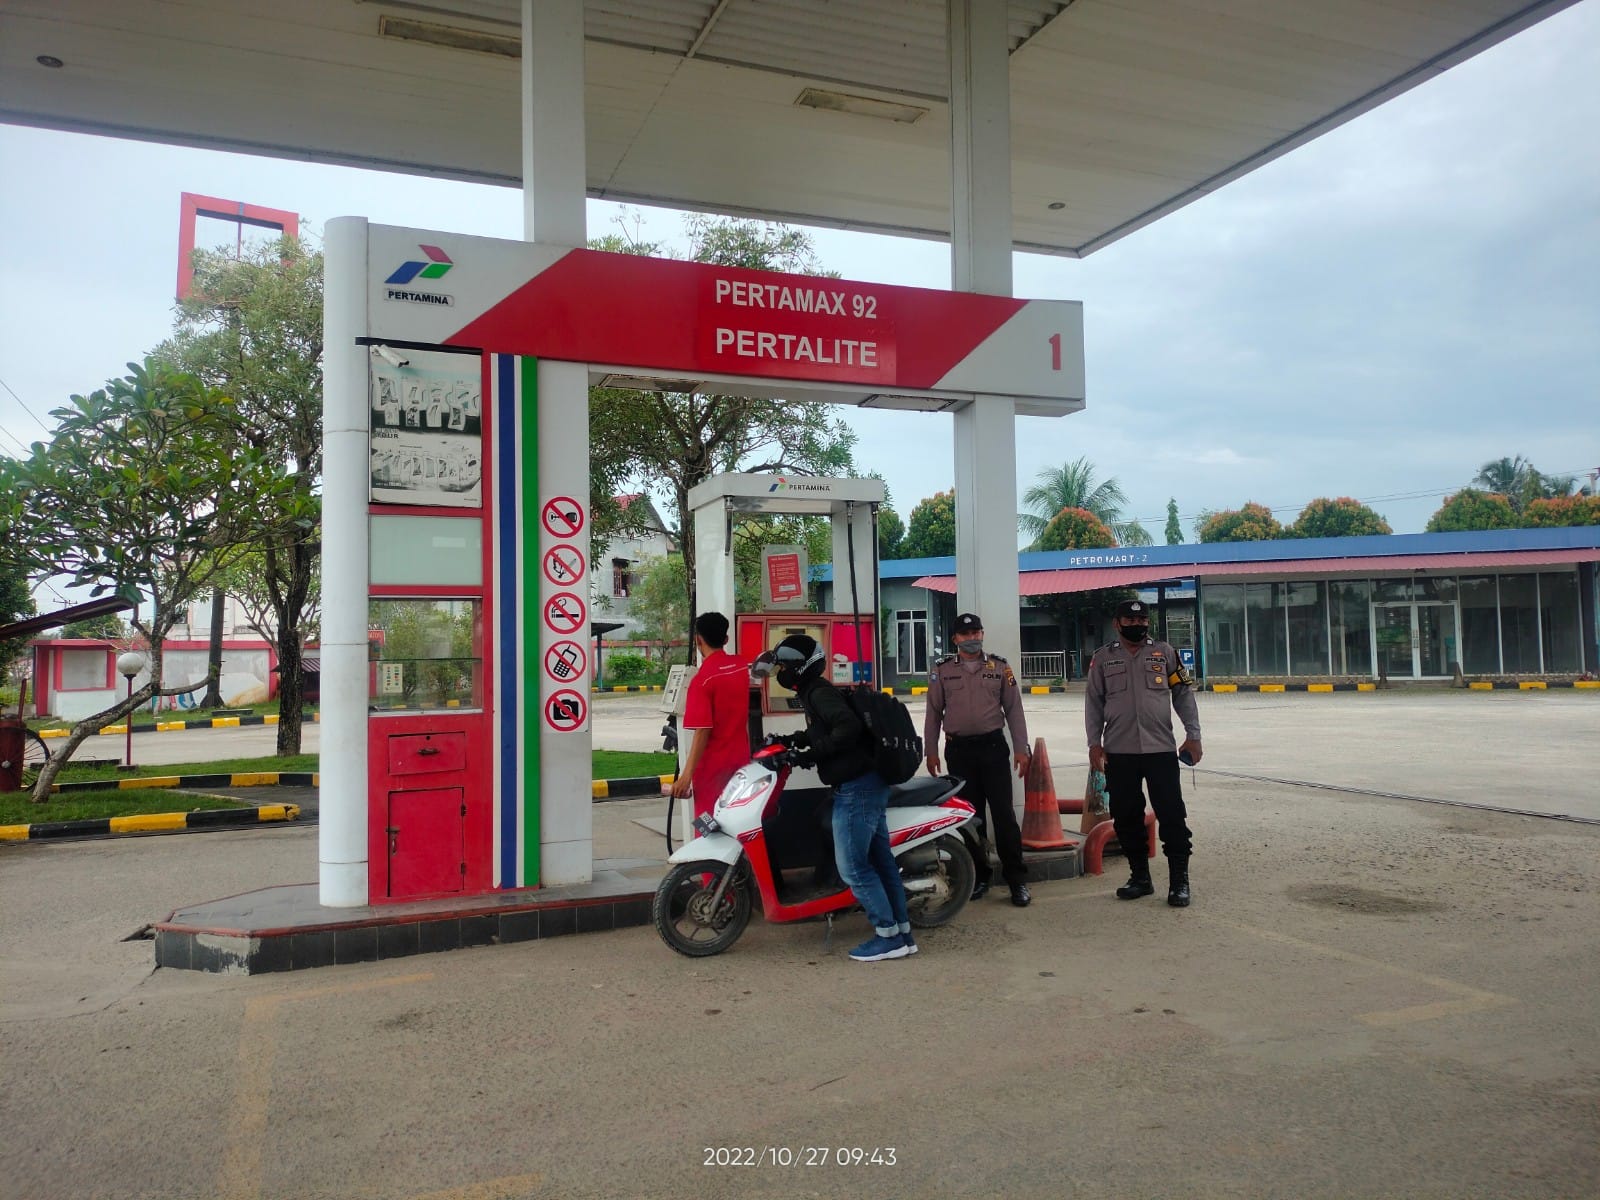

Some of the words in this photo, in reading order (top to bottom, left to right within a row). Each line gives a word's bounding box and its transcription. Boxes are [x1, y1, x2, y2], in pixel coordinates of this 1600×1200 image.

[388, 290, 449, 305] PERTAMINA
[715, 279, 847, 316] PERTAMAX
[852, 294, 877, 319] 92
[716, 327, 877, 367] PERTALITE
[1048, 333, 1061, 371] 1
[1183, 652, 1191, 661] P
